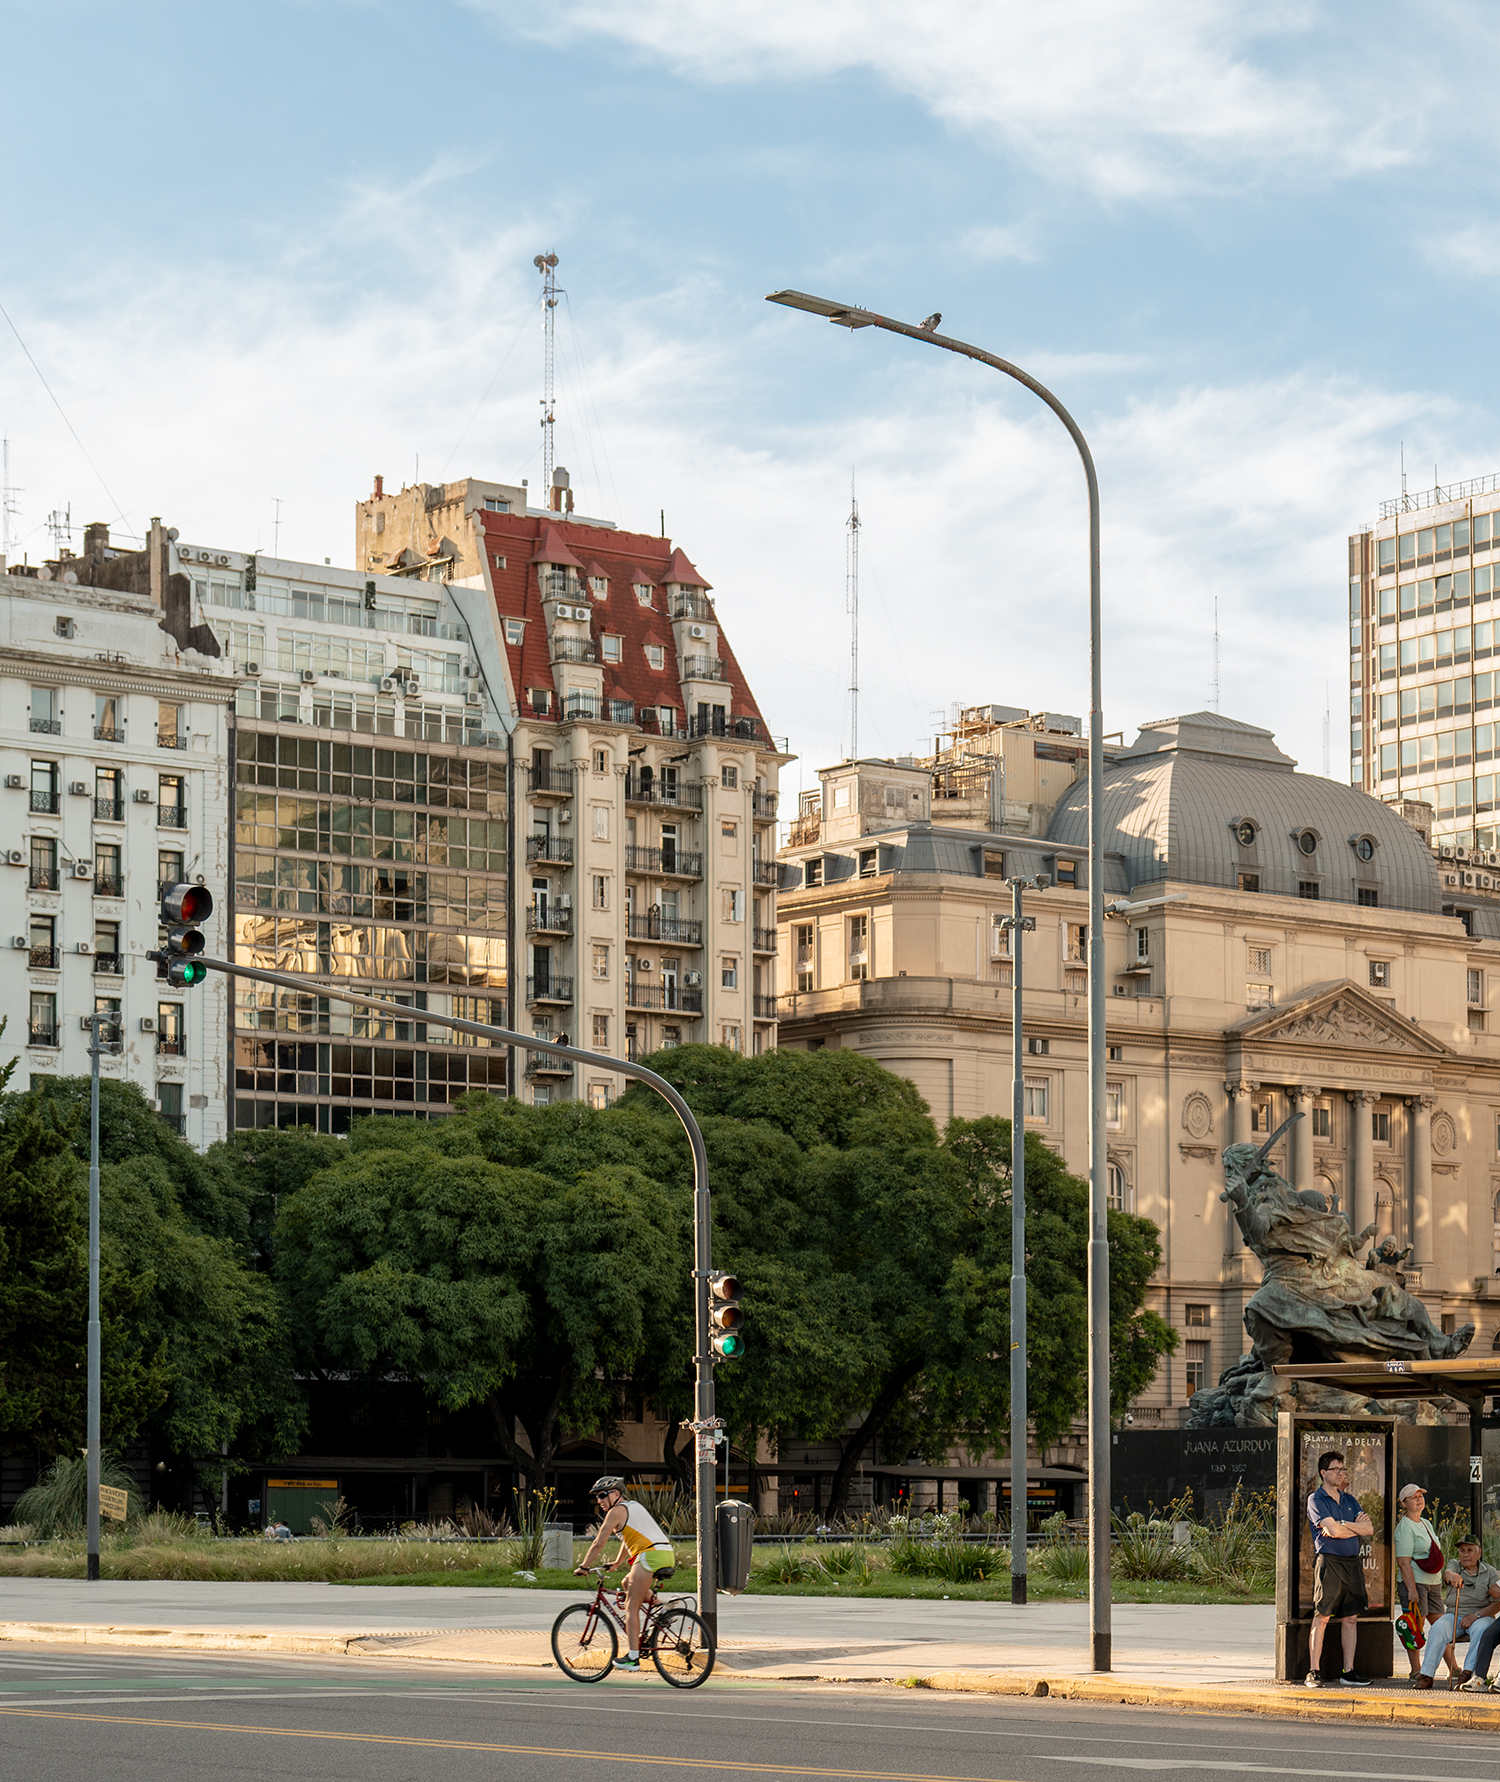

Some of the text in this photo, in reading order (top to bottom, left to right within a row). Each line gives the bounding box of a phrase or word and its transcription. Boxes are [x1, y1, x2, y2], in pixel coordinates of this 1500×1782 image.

[1262, 1057, 1412, 1080] BOLSA DE COMERCIO
[1184, 1440, 1273, 1454] JUANA AZURDUY
[1312, 1435, 1382, 1446] LATAM DELTA
